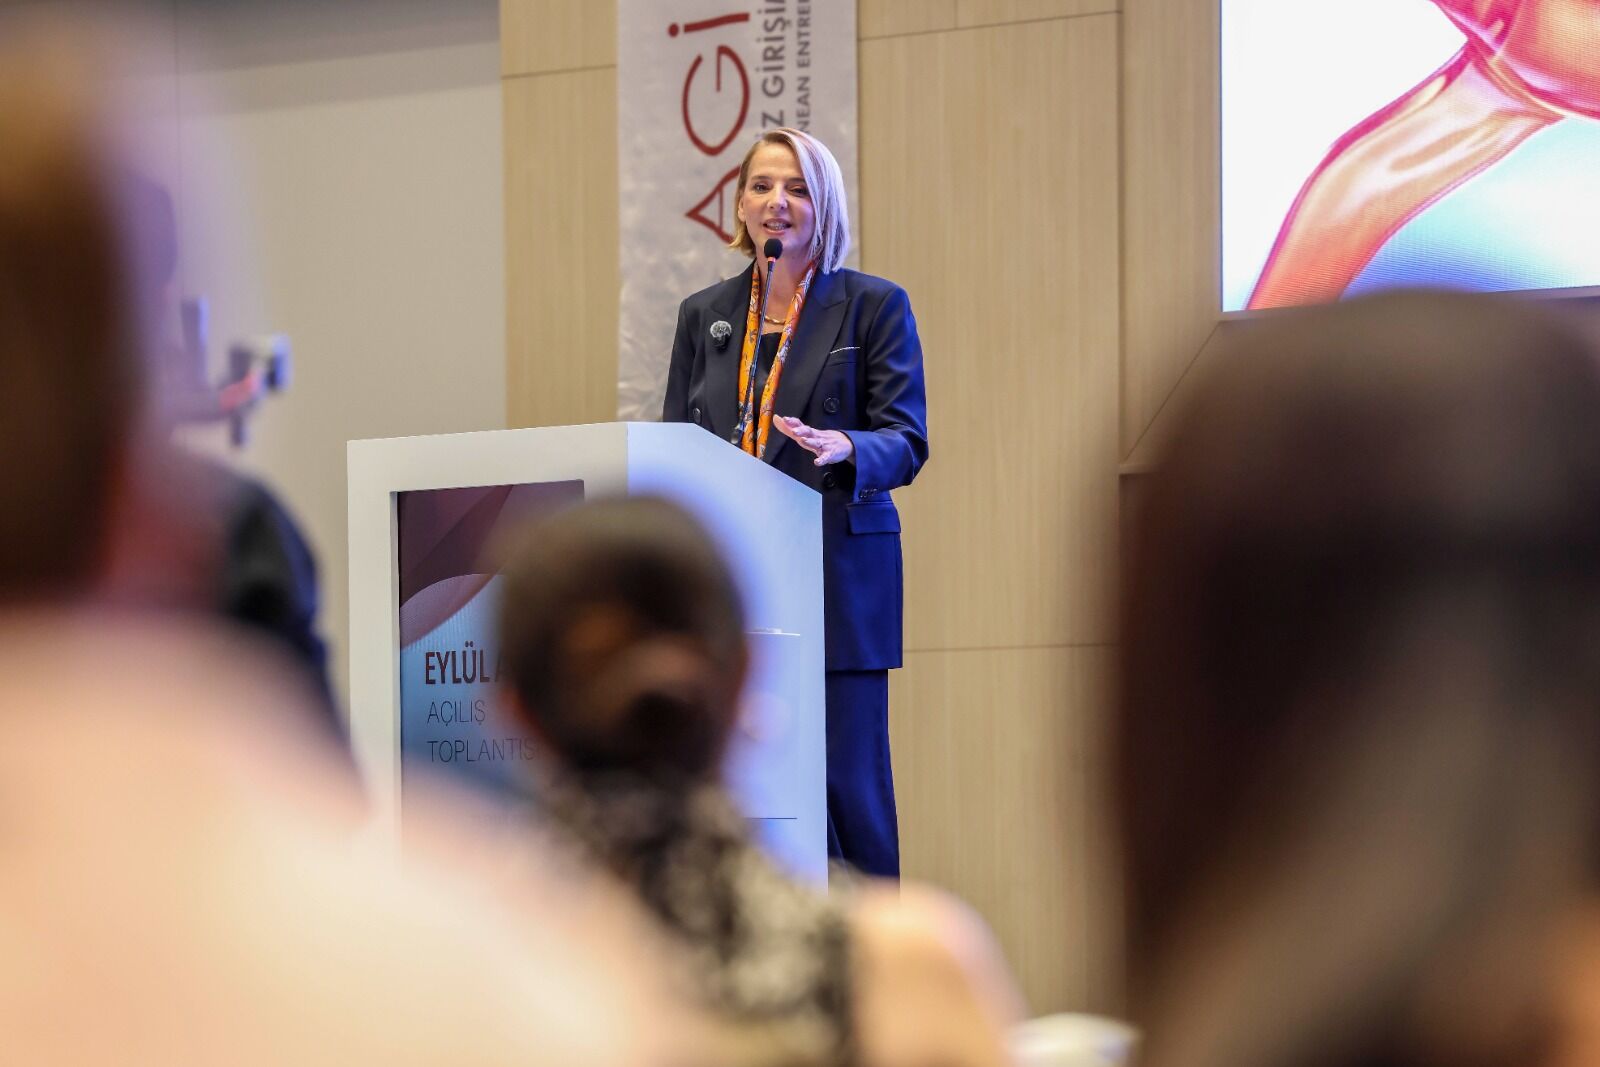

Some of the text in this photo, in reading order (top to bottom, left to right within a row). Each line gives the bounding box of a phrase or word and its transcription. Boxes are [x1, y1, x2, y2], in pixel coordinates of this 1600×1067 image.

[755, 0, 790, 98] GİRİŞİ
[797, 0, 811, 69] ENTRE
[425, 640, 490, 685] EYLÜL
[426, 699, 486, 727] AÇILIŞ
[426, 738, 540, 763] TOPLANTIS
